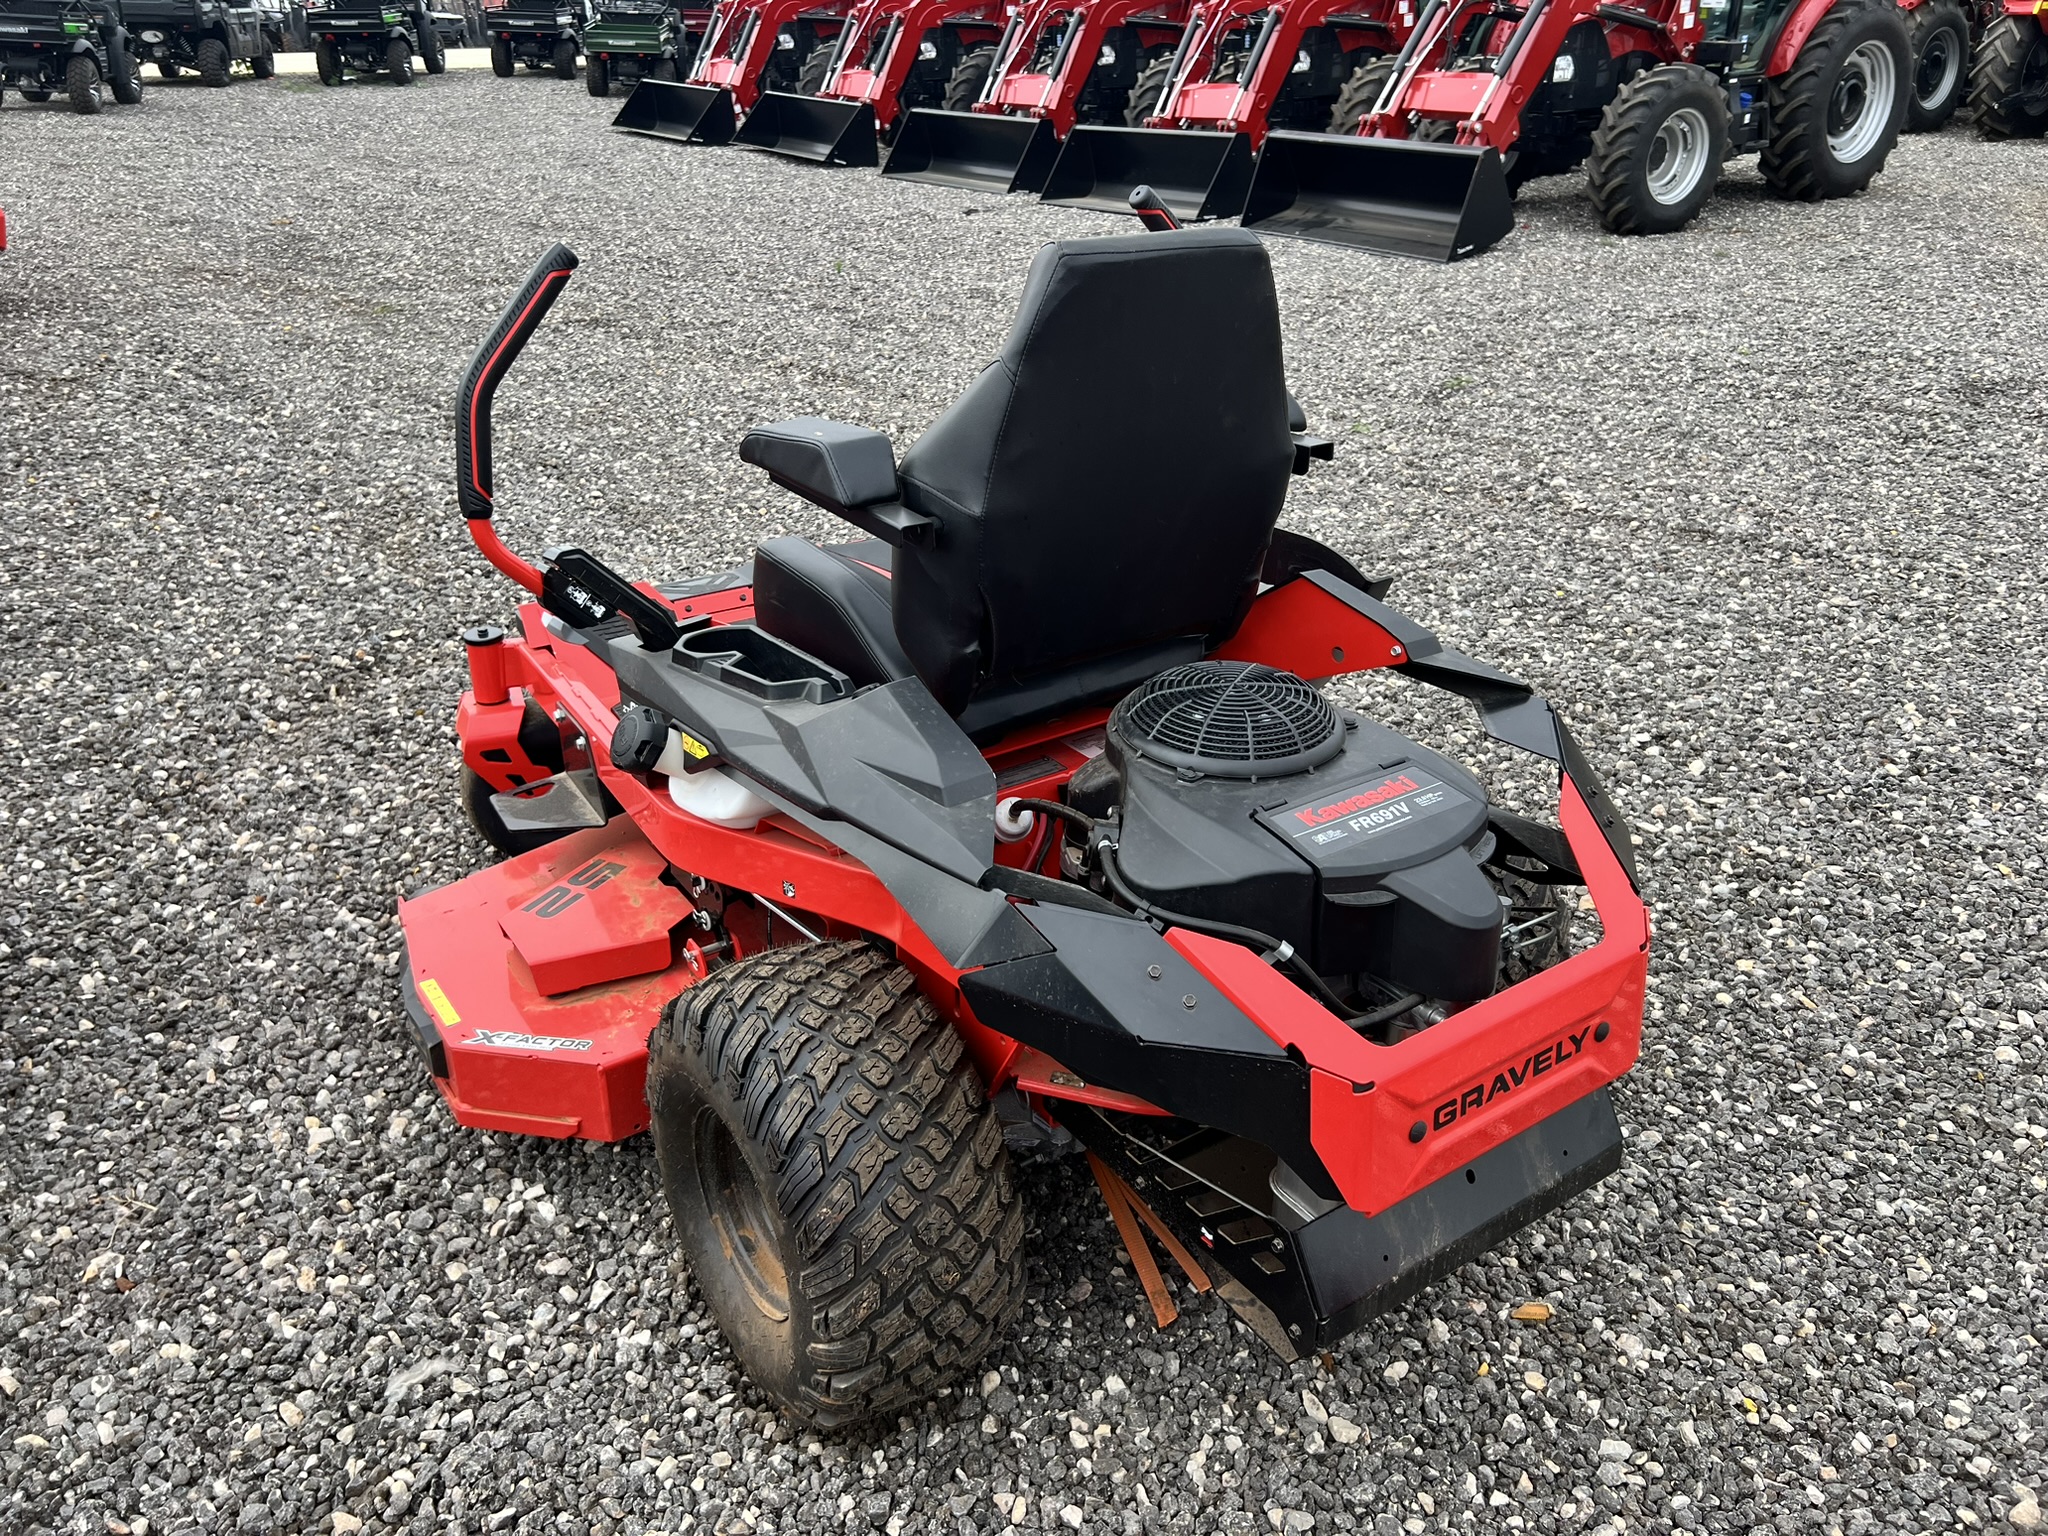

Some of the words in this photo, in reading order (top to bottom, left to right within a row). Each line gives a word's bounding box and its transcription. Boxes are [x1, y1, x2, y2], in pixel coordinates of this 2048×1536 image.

[1295, 775, 1420, 827] Kawasaki
[1348, 801, 1411, 832] FR691V
[470, 1030, 592, 1049] X-FACTOR
[1433, 1025, 1592, 1131] GRAVELY
